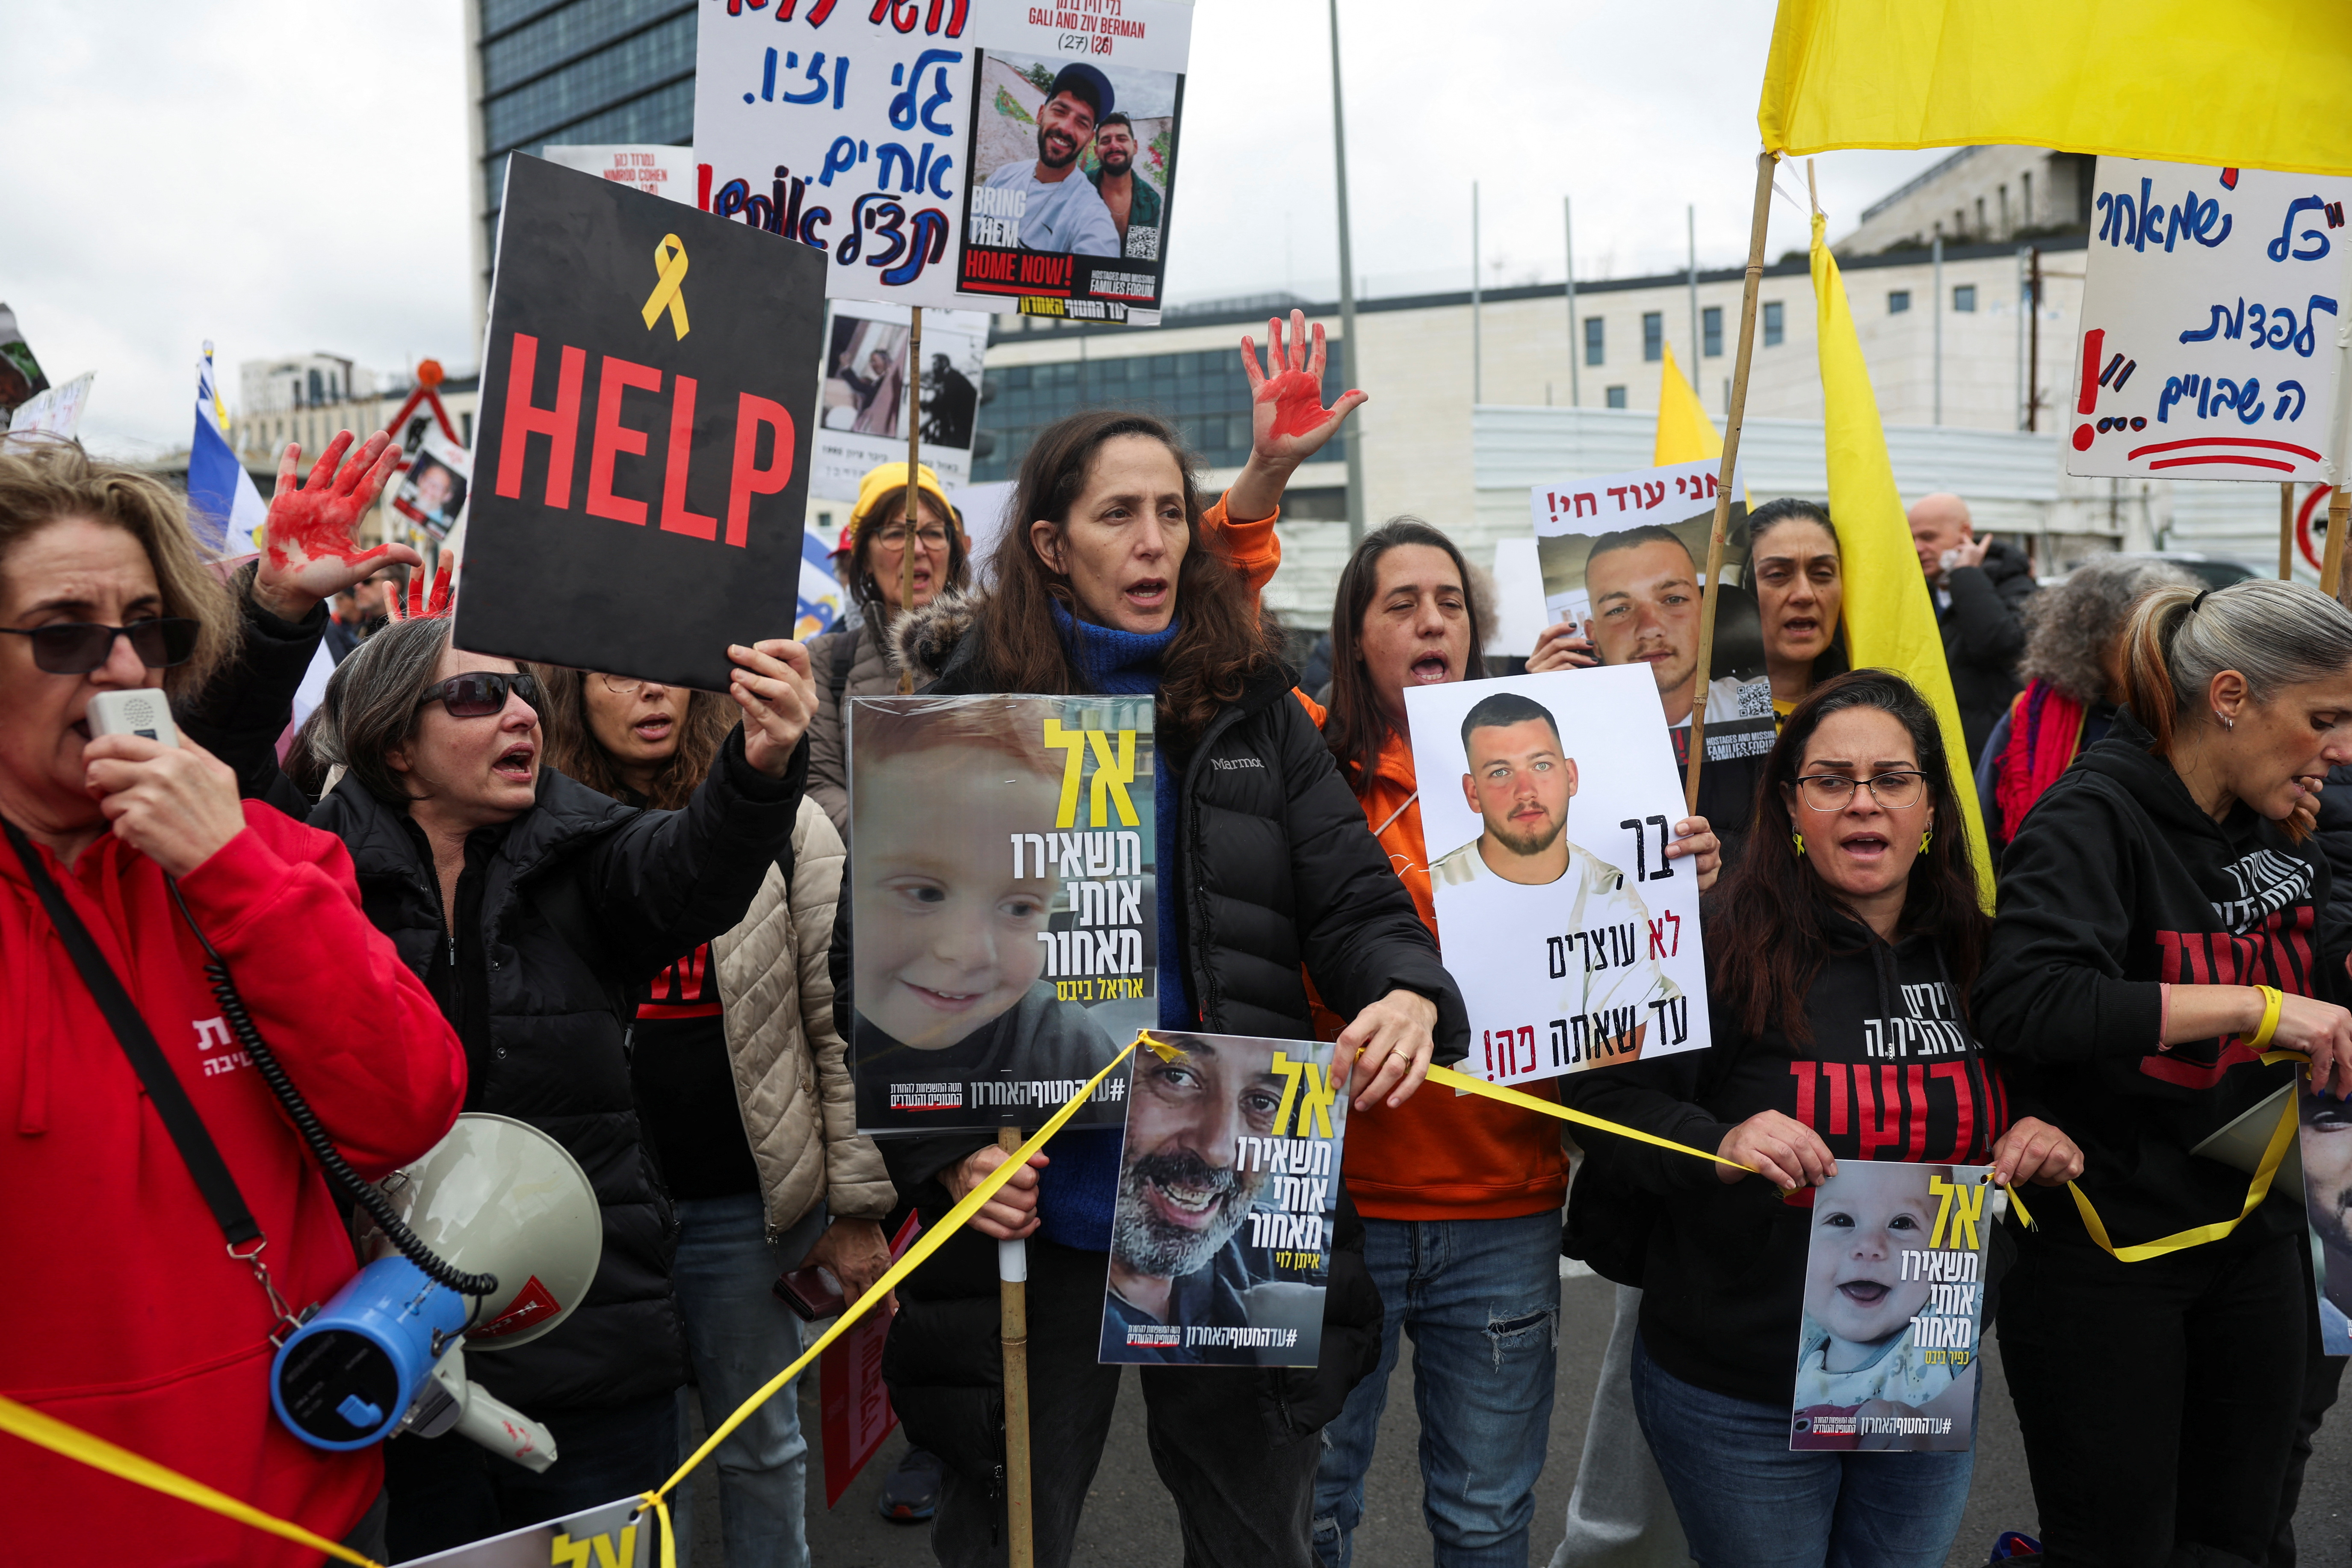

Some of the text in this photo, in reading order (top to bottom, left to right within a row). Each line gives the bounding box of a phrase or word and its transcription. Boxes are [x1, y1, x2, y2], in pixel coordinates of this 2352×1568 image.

[1029, 7, 1145, 38] GALI AND ZIV BERMAN
[1058, 32, 1088, 53] (27)
[889, 49, 963, 136] גלי
[603, 168, 668, 181] NIMROD COHEN
[972, 186, 1026, 219] BRING
[2096, 177, 2232, 253] שמאחר
[836, 192, 949, 286] תציל
[969, 217, 1019, 248] THEM
[965, 249, 1074, 286] HOME NOW!
[1091, 270, 1119, 281] HOSTAGES
[1120, 272, 1131, 282] AND
[1090, 279, 1155, 297] FAMILIES FORUM
[1019, 296, 1125, 319] עד החטוף האחרון
[495, 332, 796, 548] HELP
[1547, 491, 1598, 523] חי!
[1607, 481, 1665, 511] עוד
[1706, 735, 1737, 746] HOSTAGES
[1738, 732, 1751, 742] AND
[1044, 719, 1140, 828] אל
[1210, 758, 1265, 770] Marmot
[1011, 830, 1141, 879] תשאירו
[1067, 880, 1143, 926] אותי
[1037, 929, 1142, 976] מאחור
[1546, 909, 1680, 979] לא עוצרים
[1056, 977, 1143, 1001] אריאל ביבס
[1483, 996, 1687, 1081] עד שאתה פה!
[890, 1083, 962, 1093] מטה המשפחות להחזרת
[890, 1093, 962, 1107] החטופים והנעדרים
[1271, 1051, 1336, 1138] אל
[1237, 1136, 1332, 1176] תשאירו
[1273, 1176, 1329, 1213] אותי
[1928, 1175, 1985, 1250] אל
[1247, 1214, 1323, 1250] מאחור
[1276, 1250, 1320, 1270] איתן לוי
[1900, 1250, 1978, 1282] תשאירו
[1930, 1283, 1974, 1315] אותי
[1126, 1333, 1180, 1345] החטופים והנעדרים
[1128, 1325, 1146, 1333] להחזרת
[1170, 1326, 1181, 1334] מטה
[1186, 1326, 1297, 1349] #עדהחטוףהאחרון
[1910, 1316, 1971, 1348] מאחור
[1925, 1350, 1970, 1365] כפיר ביבס
[1813, 1424, 1856, 1433] החטופים והנעדרים
[1861, 1417, 1952, 1436] #עדהחטוףהאחרון
